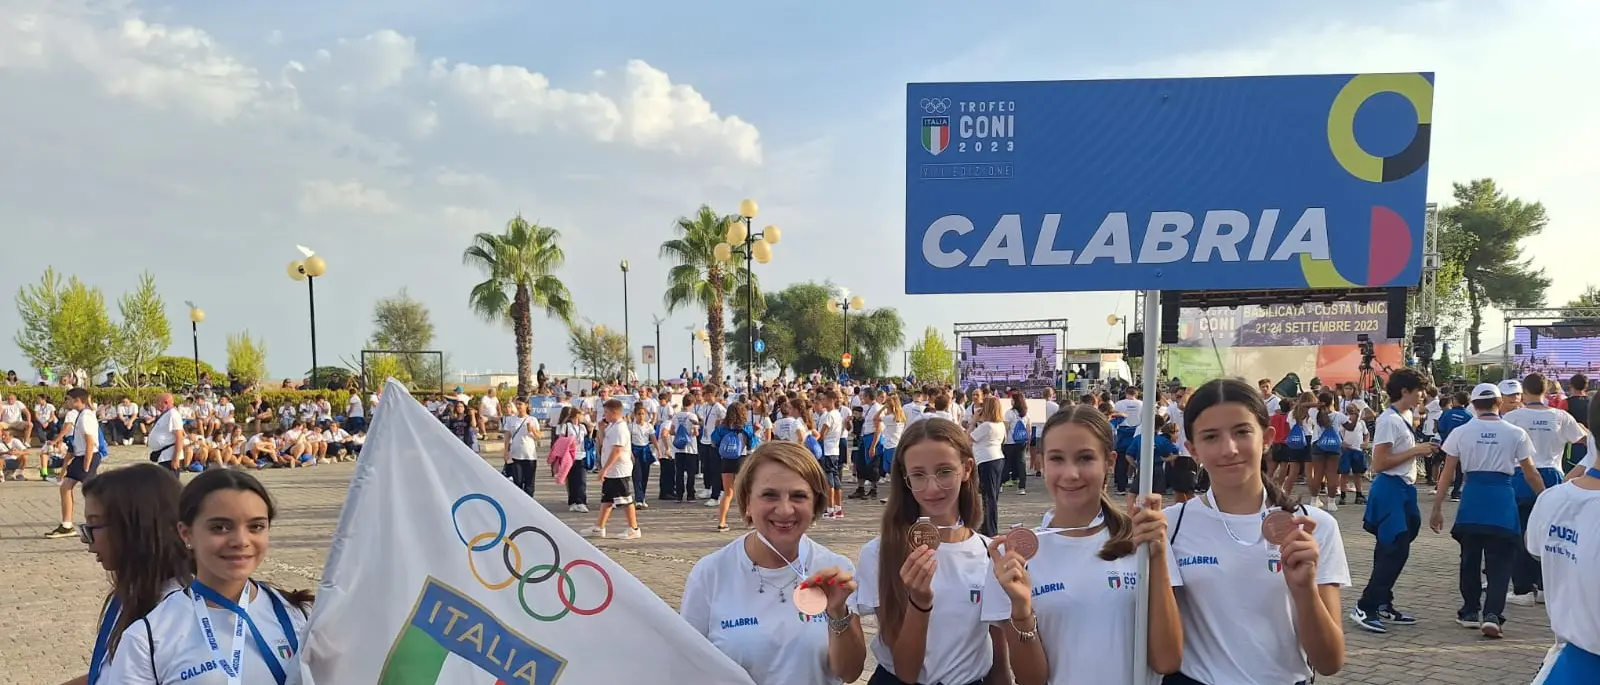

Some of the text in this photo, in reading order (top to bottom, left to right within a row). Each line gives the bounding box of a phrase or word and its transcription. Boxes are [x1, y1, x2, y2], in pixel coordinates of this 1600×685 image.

[959, 101, 1015, 113] TROFEO
[959, 114, 1014, 138] CONI
[958, 141, 1014, 153] 2023
[952, 165, 1012, 177] EDIZIONE
[921, 207, 1332, 269] CALABRIA
[1243, 305, 1306, 318] BASILICATA
[1314, 303, 1351, 316] COSTA
[1354, 302, 1387, 315] IONIC
[1199, 317, 1235, 331] CONI
[1255, 319, 1379, 334] 21-24 SETTEMBRE 2023
[1178, 555, 1219, 567] CALABRIA
[1123, 576, 1136, 586] CO
[1031, 582, 1066, 597] LABRIA
[720, 617, 759, 630] CALABRIA
[427, 600, 539, 685] ITALIA
